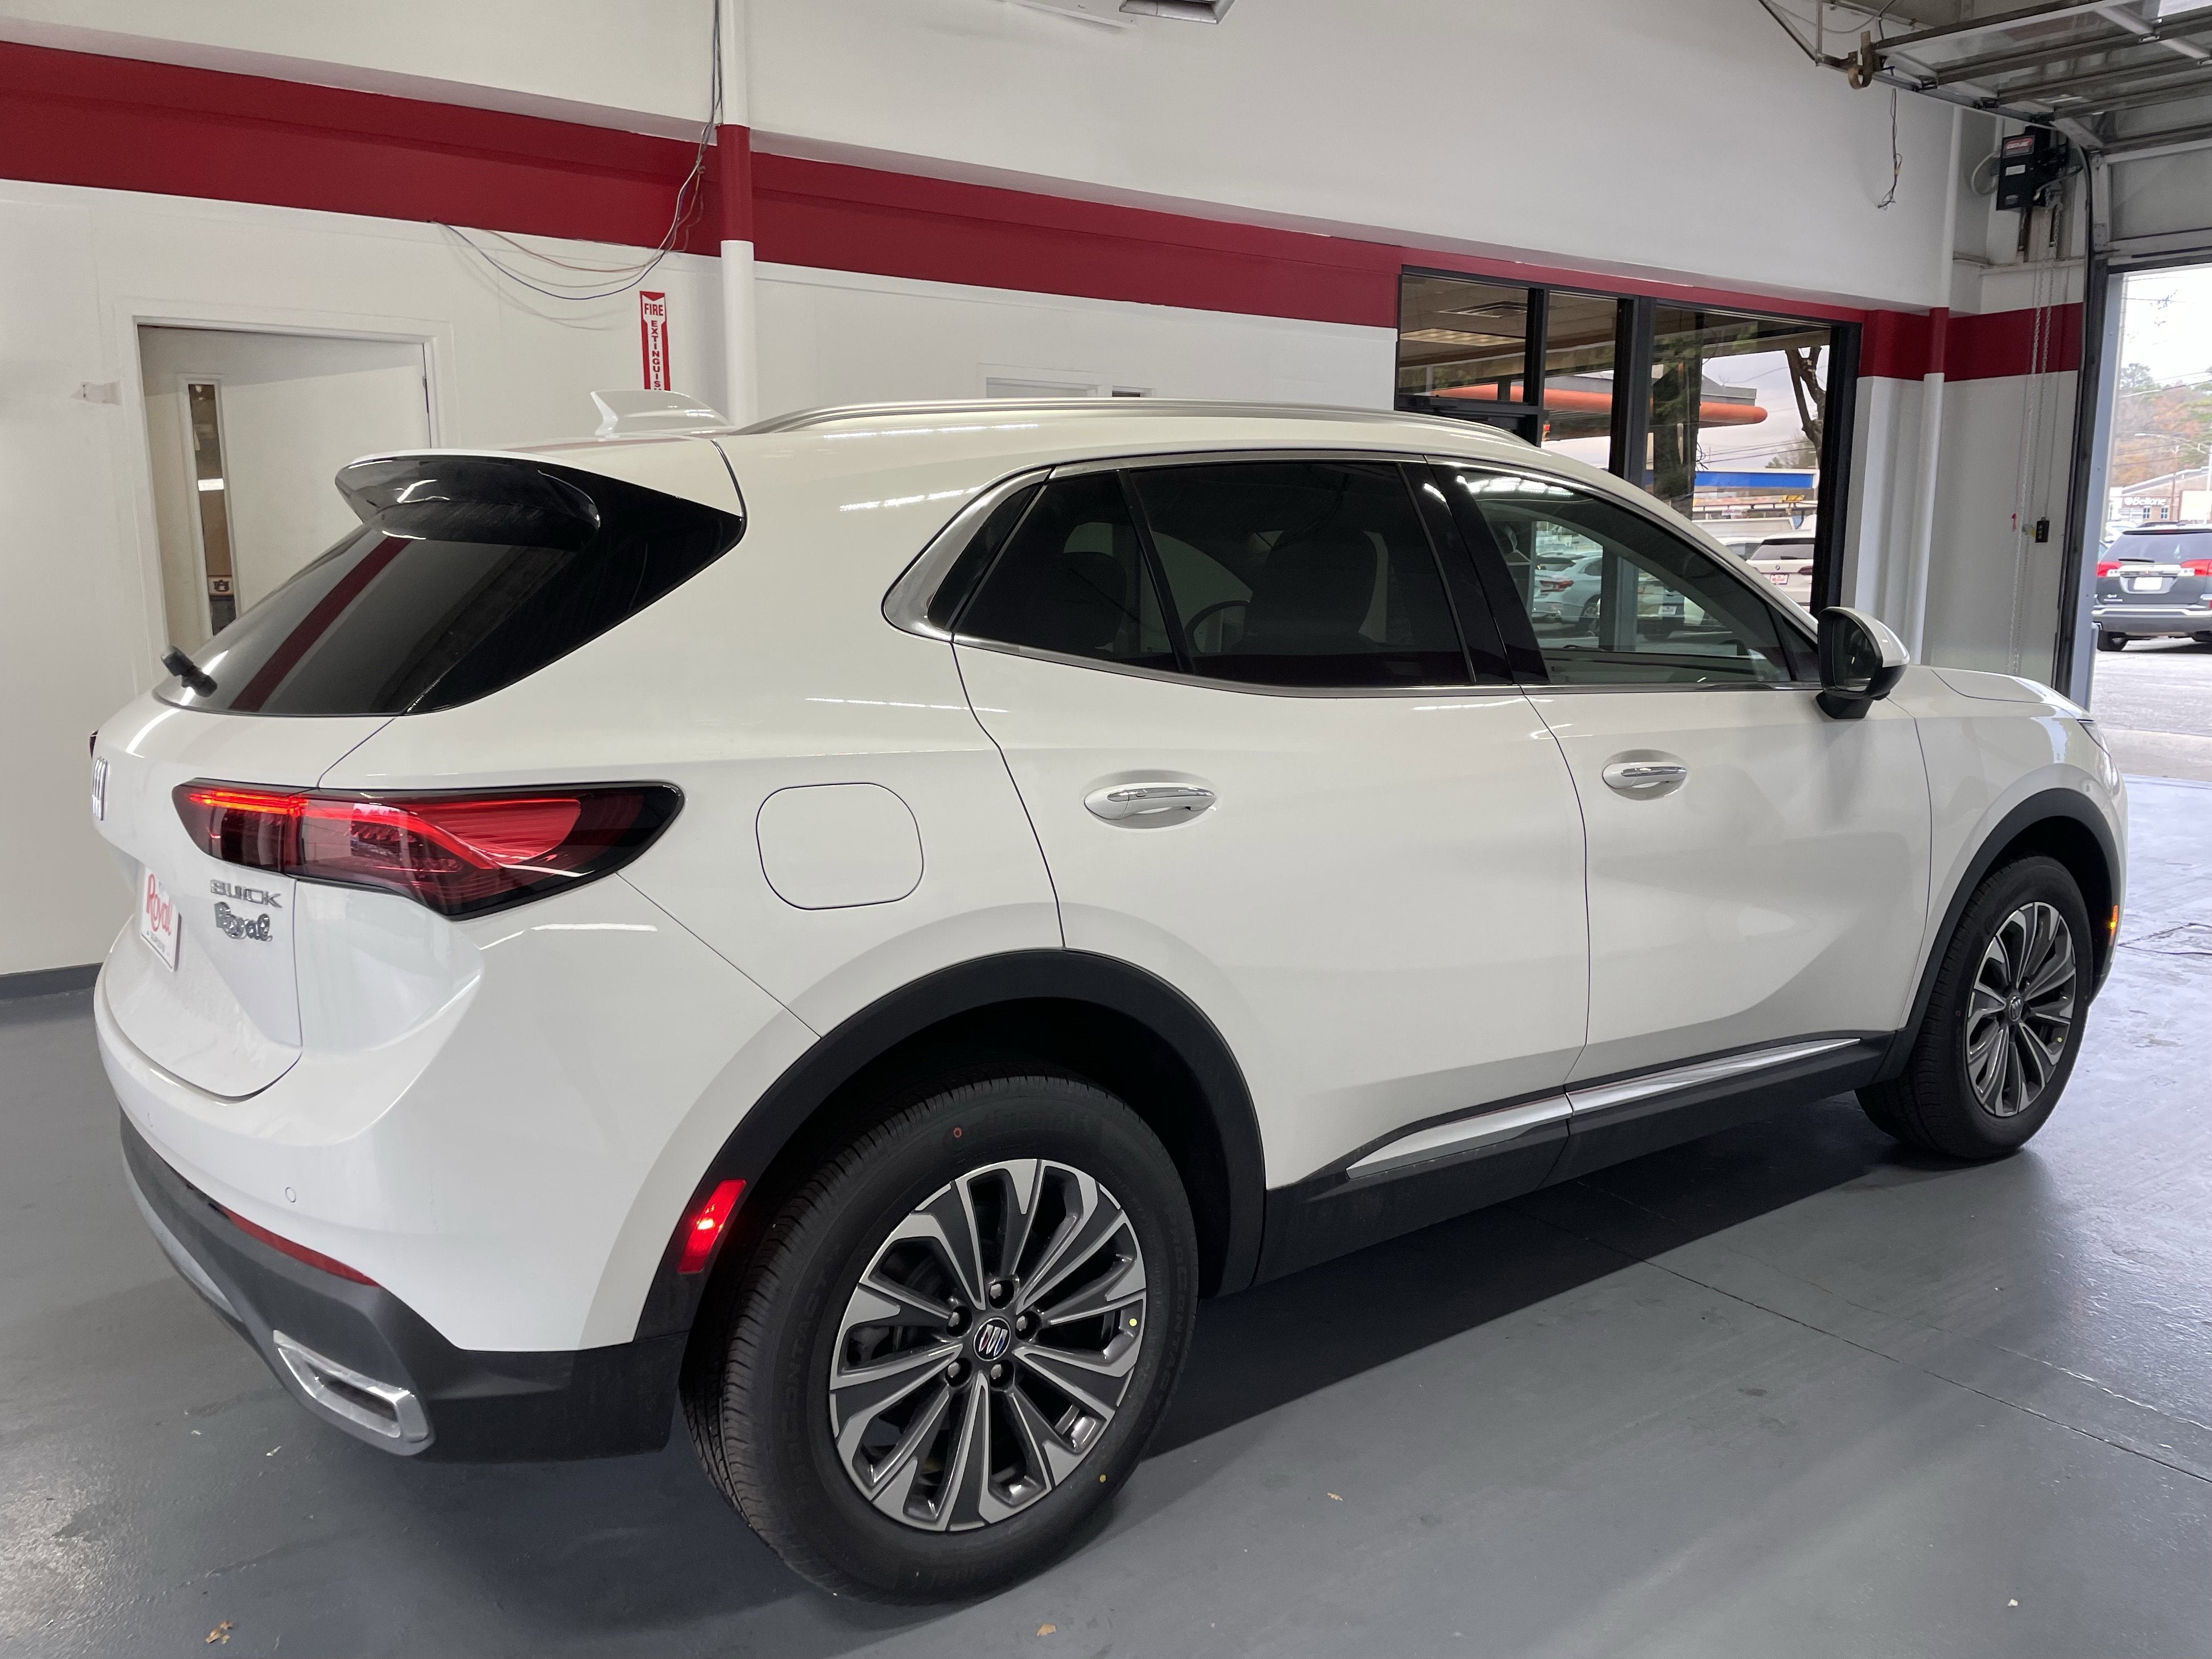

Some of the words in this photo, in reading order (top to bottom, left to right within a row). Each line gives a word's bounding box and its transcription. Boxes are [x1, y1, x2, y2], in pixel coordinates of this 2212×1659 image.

[645, 303, 663, 316] FIRE
[651, 320, 662, 390] EXTINGUIS
[210, 879, 283, 909] BUICK
